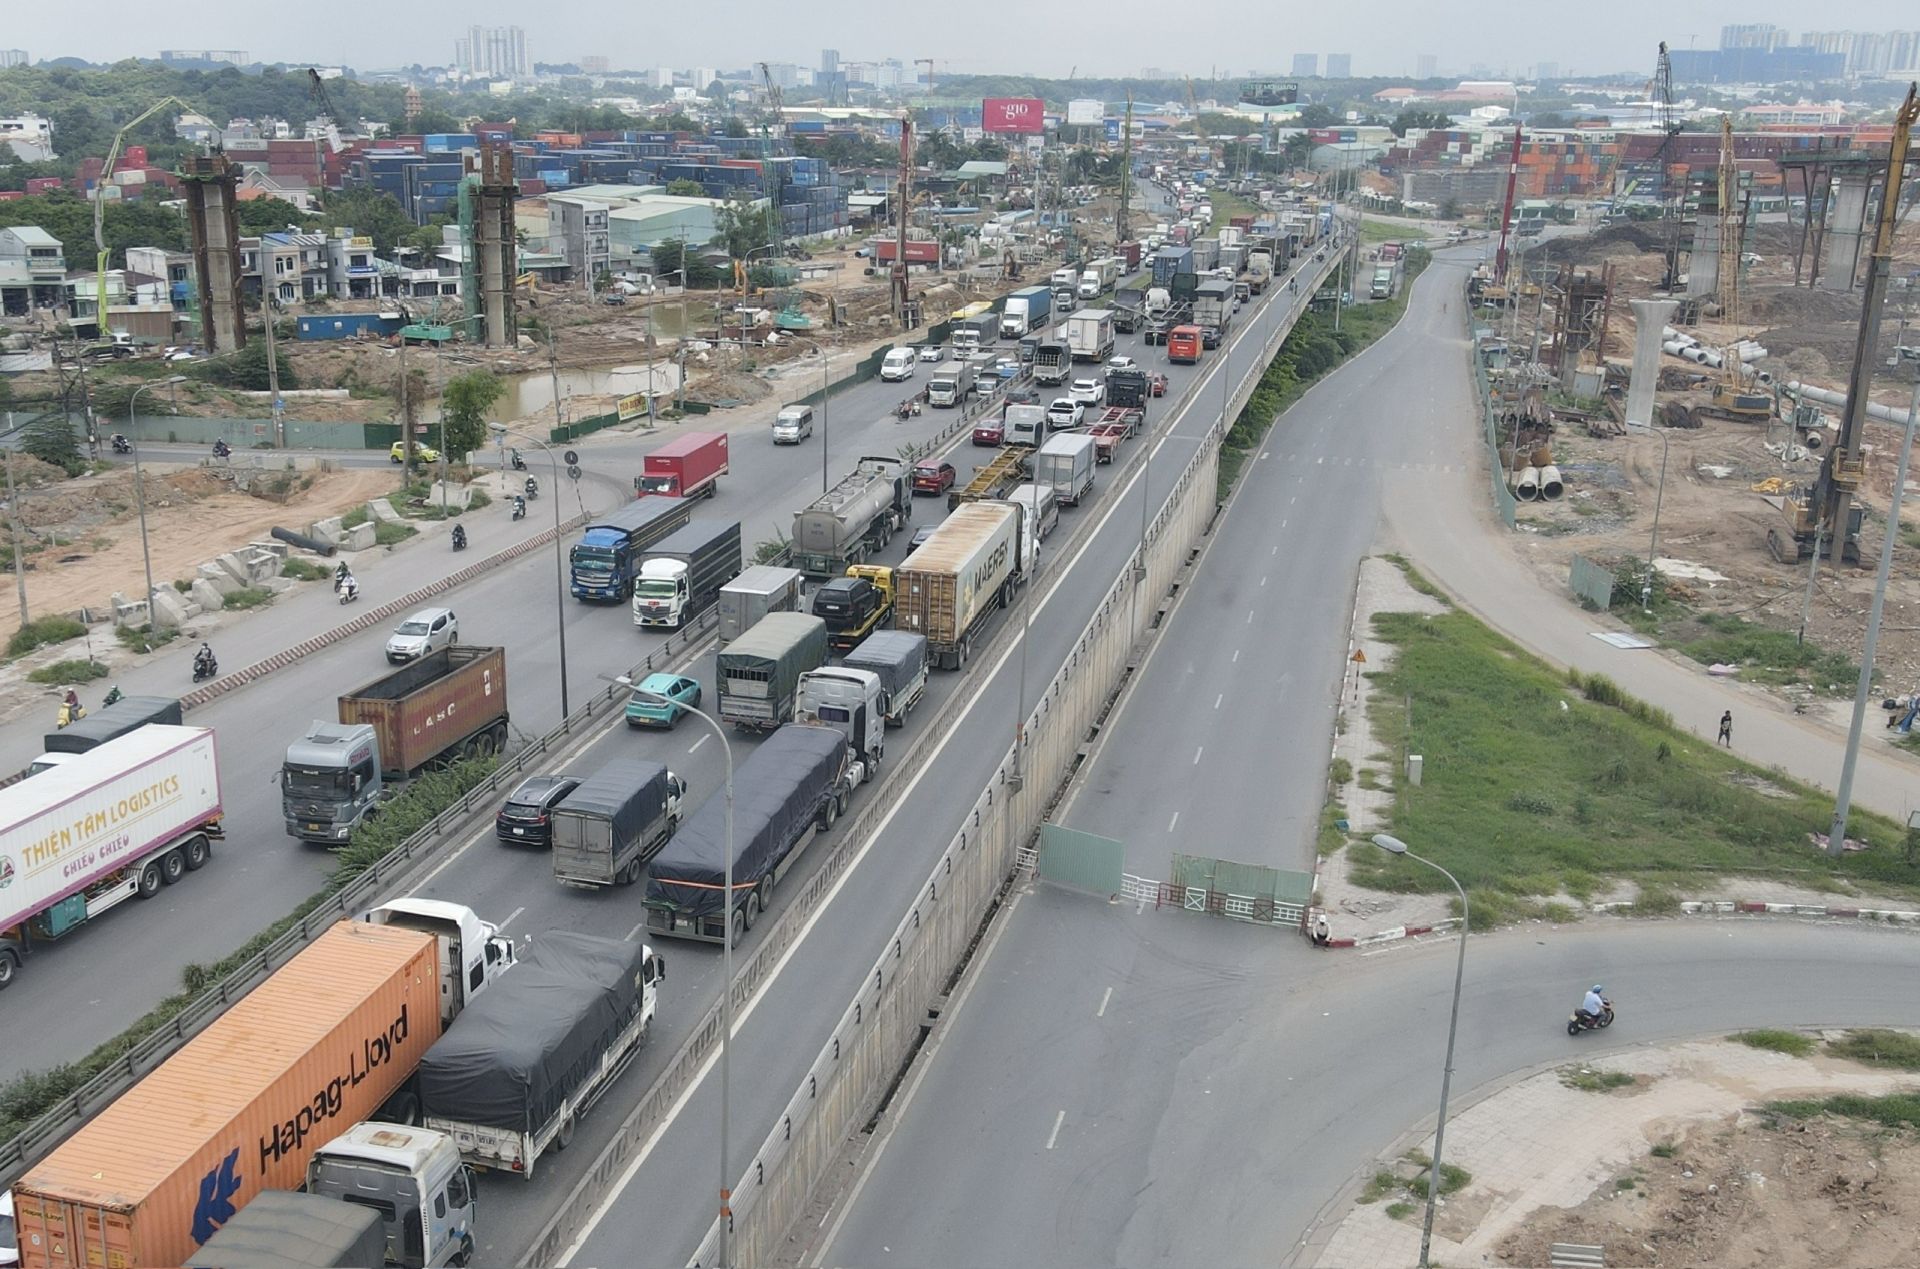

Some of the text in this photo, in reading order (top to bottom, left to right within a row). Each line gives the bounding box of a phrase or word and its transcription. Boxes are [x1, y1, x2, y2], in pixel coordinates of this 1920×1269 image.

[75, 811, 107, 841] TÂM
[111, 775, 179, 824] LOGISTICS
[259, 1004, 408, 1176] Hapag-Lloyd
[22, 1208, 63, 1221] HapagLloyd
